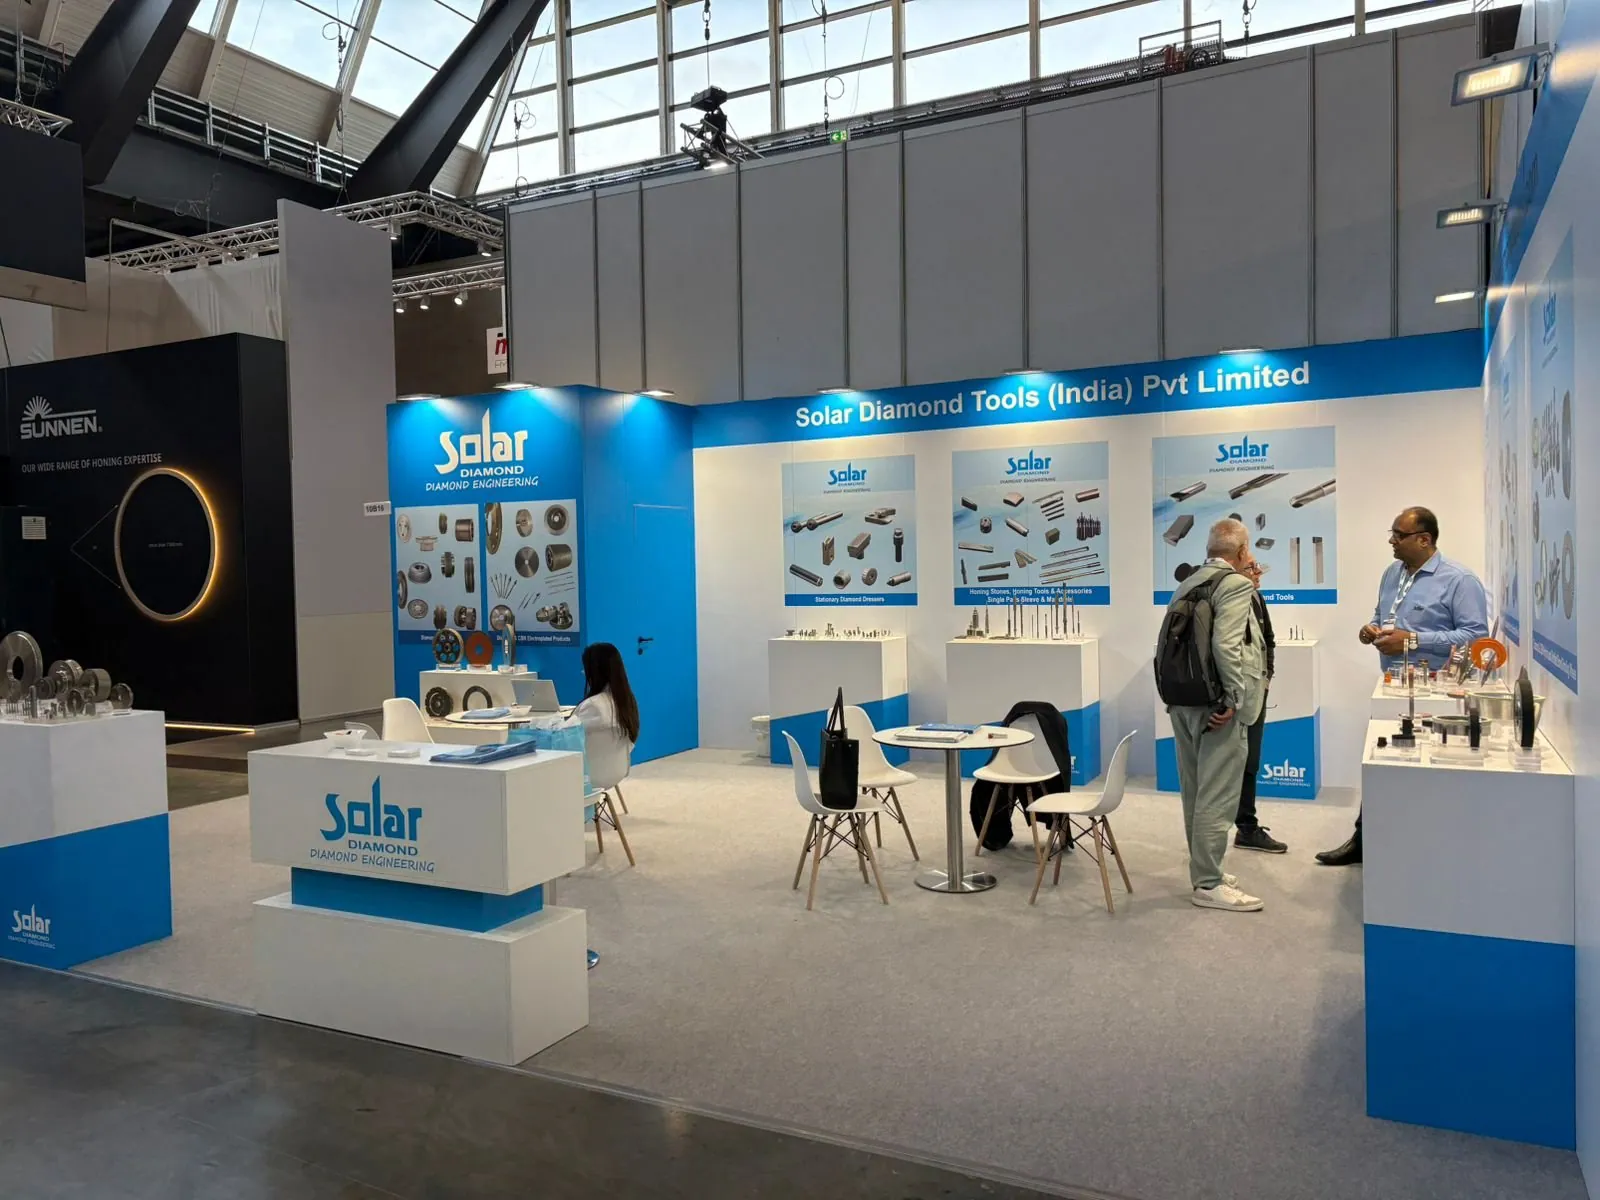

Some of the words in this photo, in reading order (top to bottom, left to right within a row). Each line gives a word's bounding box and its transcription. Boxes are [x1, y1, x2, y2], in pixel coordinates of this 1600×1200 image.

[796, 407, 852, 428] Solar
[859, 393, 963, 423] Diamond
[971, 386, 1040, 412] Tools
[1048, 377, 1132, 411] (India)
[1143, 373, 1188, 397] Pvt
[1198, 361, 1310, 393] Limited
[434, 407, 528, 475] Solar
[1215, 435, 1269, 463] Solar
[22, 463, 36, 473] OUR
[37, 462, 55, 472] WIDE
[56, 459, 80, 471] RANGE
[81, 459, 91, 469] OF
[92, 456, 122, 468] HONING
[123, 453, 162, 465] EXPERTISE
[460, 465, 524, 478] DIAMOND
[1005, 448, 1052, 475] Solar
[425, 480, 470, 491] DIAMOND
[472, 476, 539, 489] ENGINEERING
[828, 461, 867, 485] Solar
[815, 596, 839, 604] Stationary
[987, 596, 1005, 604] Single
[1276, 593, 1294, 601] Tools
[1261, 758, 1306, 779] Solar
[320, 775, 422, 841] Solar
[348, 840, 418, 857] DIAMOND
[310, 848, 358, 862] DIAMOND
[361, 854, 435, 873] ENGINEERING
[12, 904, 51, 934] Solar
